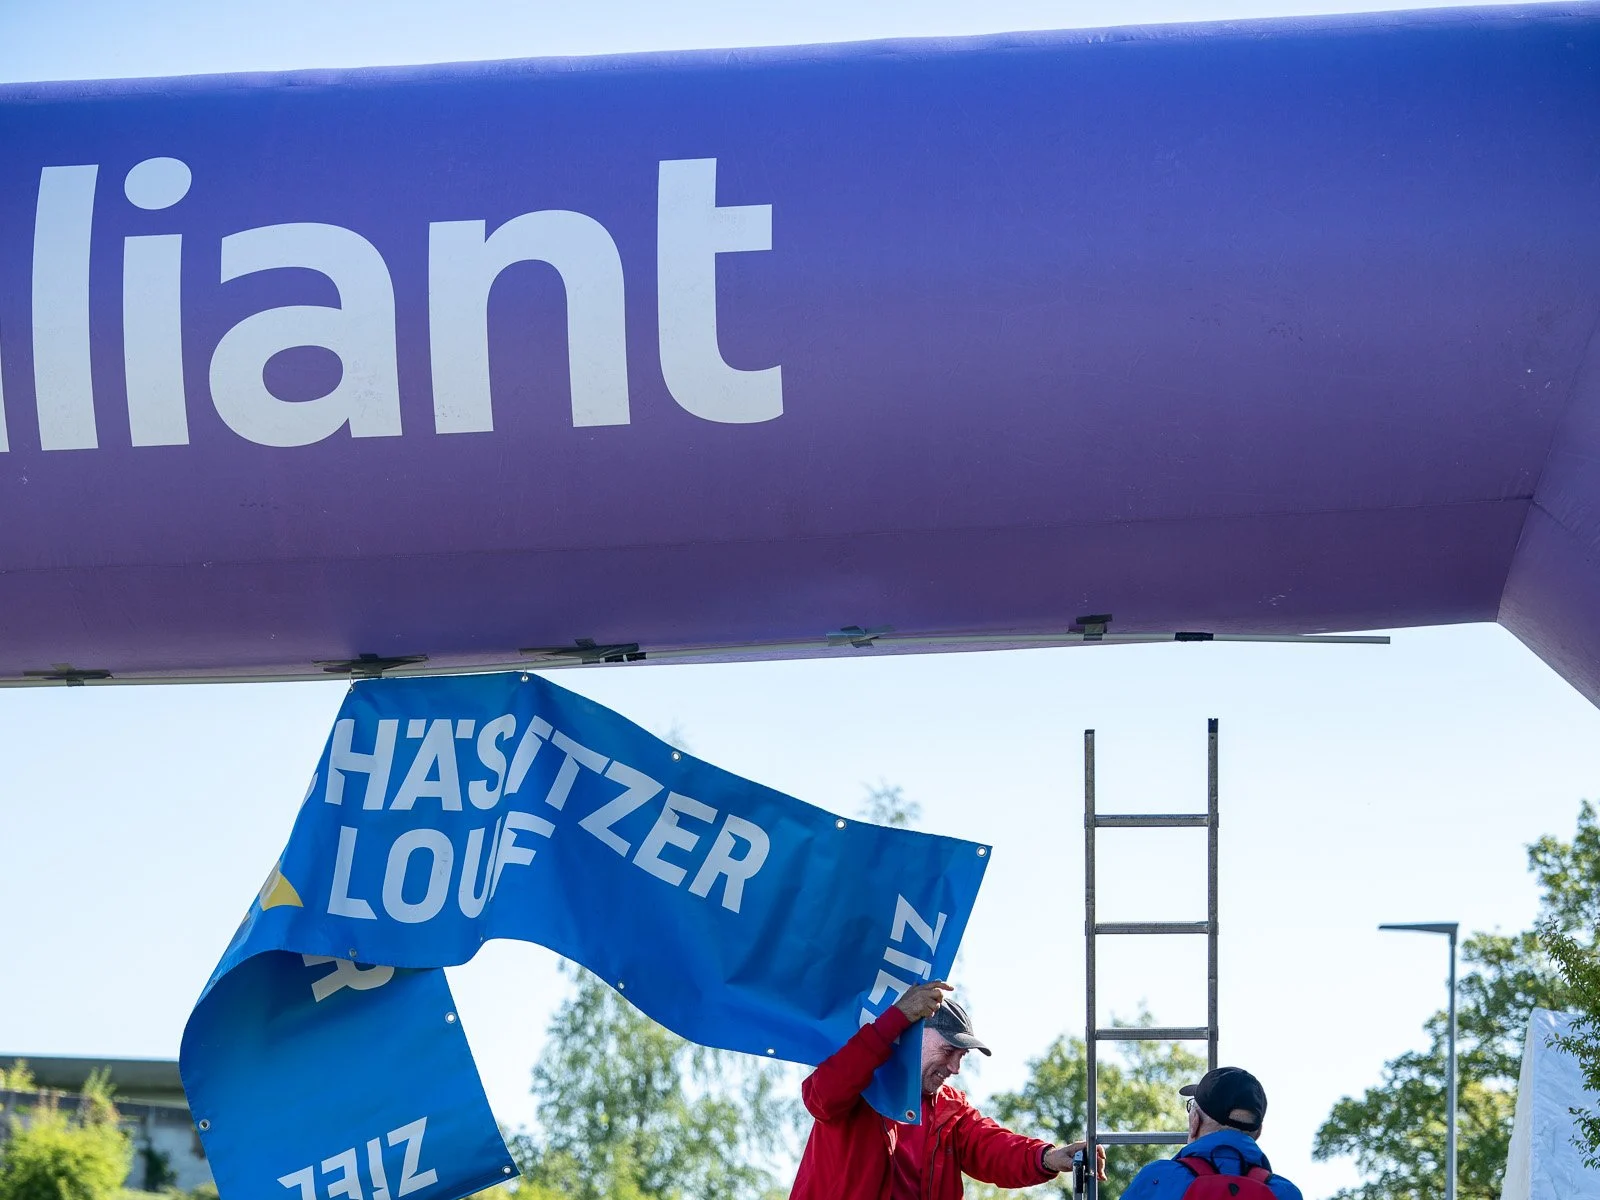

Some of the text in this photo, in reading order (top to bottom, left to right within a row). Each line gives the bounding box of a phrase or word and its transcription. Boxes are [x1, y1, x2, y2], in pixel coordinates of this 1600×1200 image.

[0, 156, 784, 454] liant
[327, 811, 557, 924] LOUF
[859, 893, 948, 1030] ZIE
